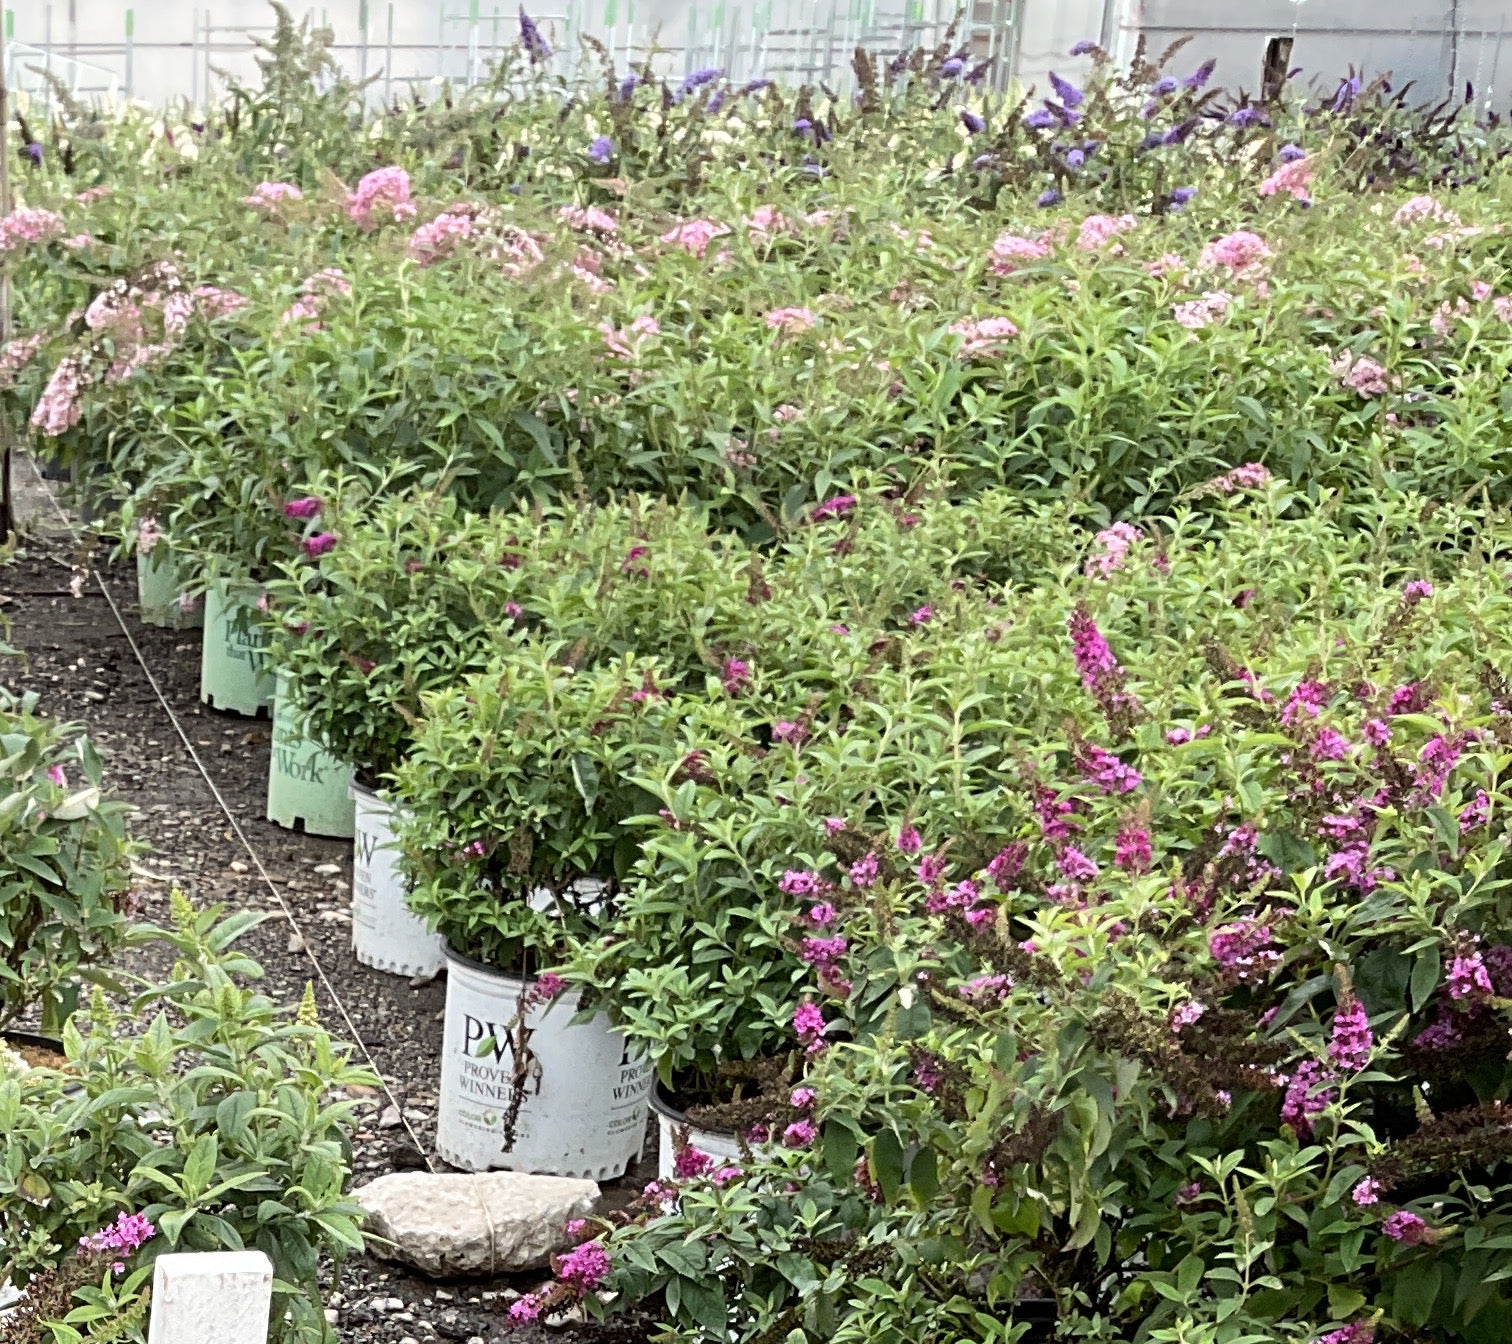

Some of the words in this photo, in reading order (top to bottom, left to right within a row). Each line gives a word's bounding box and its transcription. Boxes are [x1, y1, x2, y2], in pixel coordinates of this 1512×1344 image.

[275, 747, 324, 785] Work
[464, 1060, 512, 1085] PROVE
[621, 1065, 643, 1083] PRO
